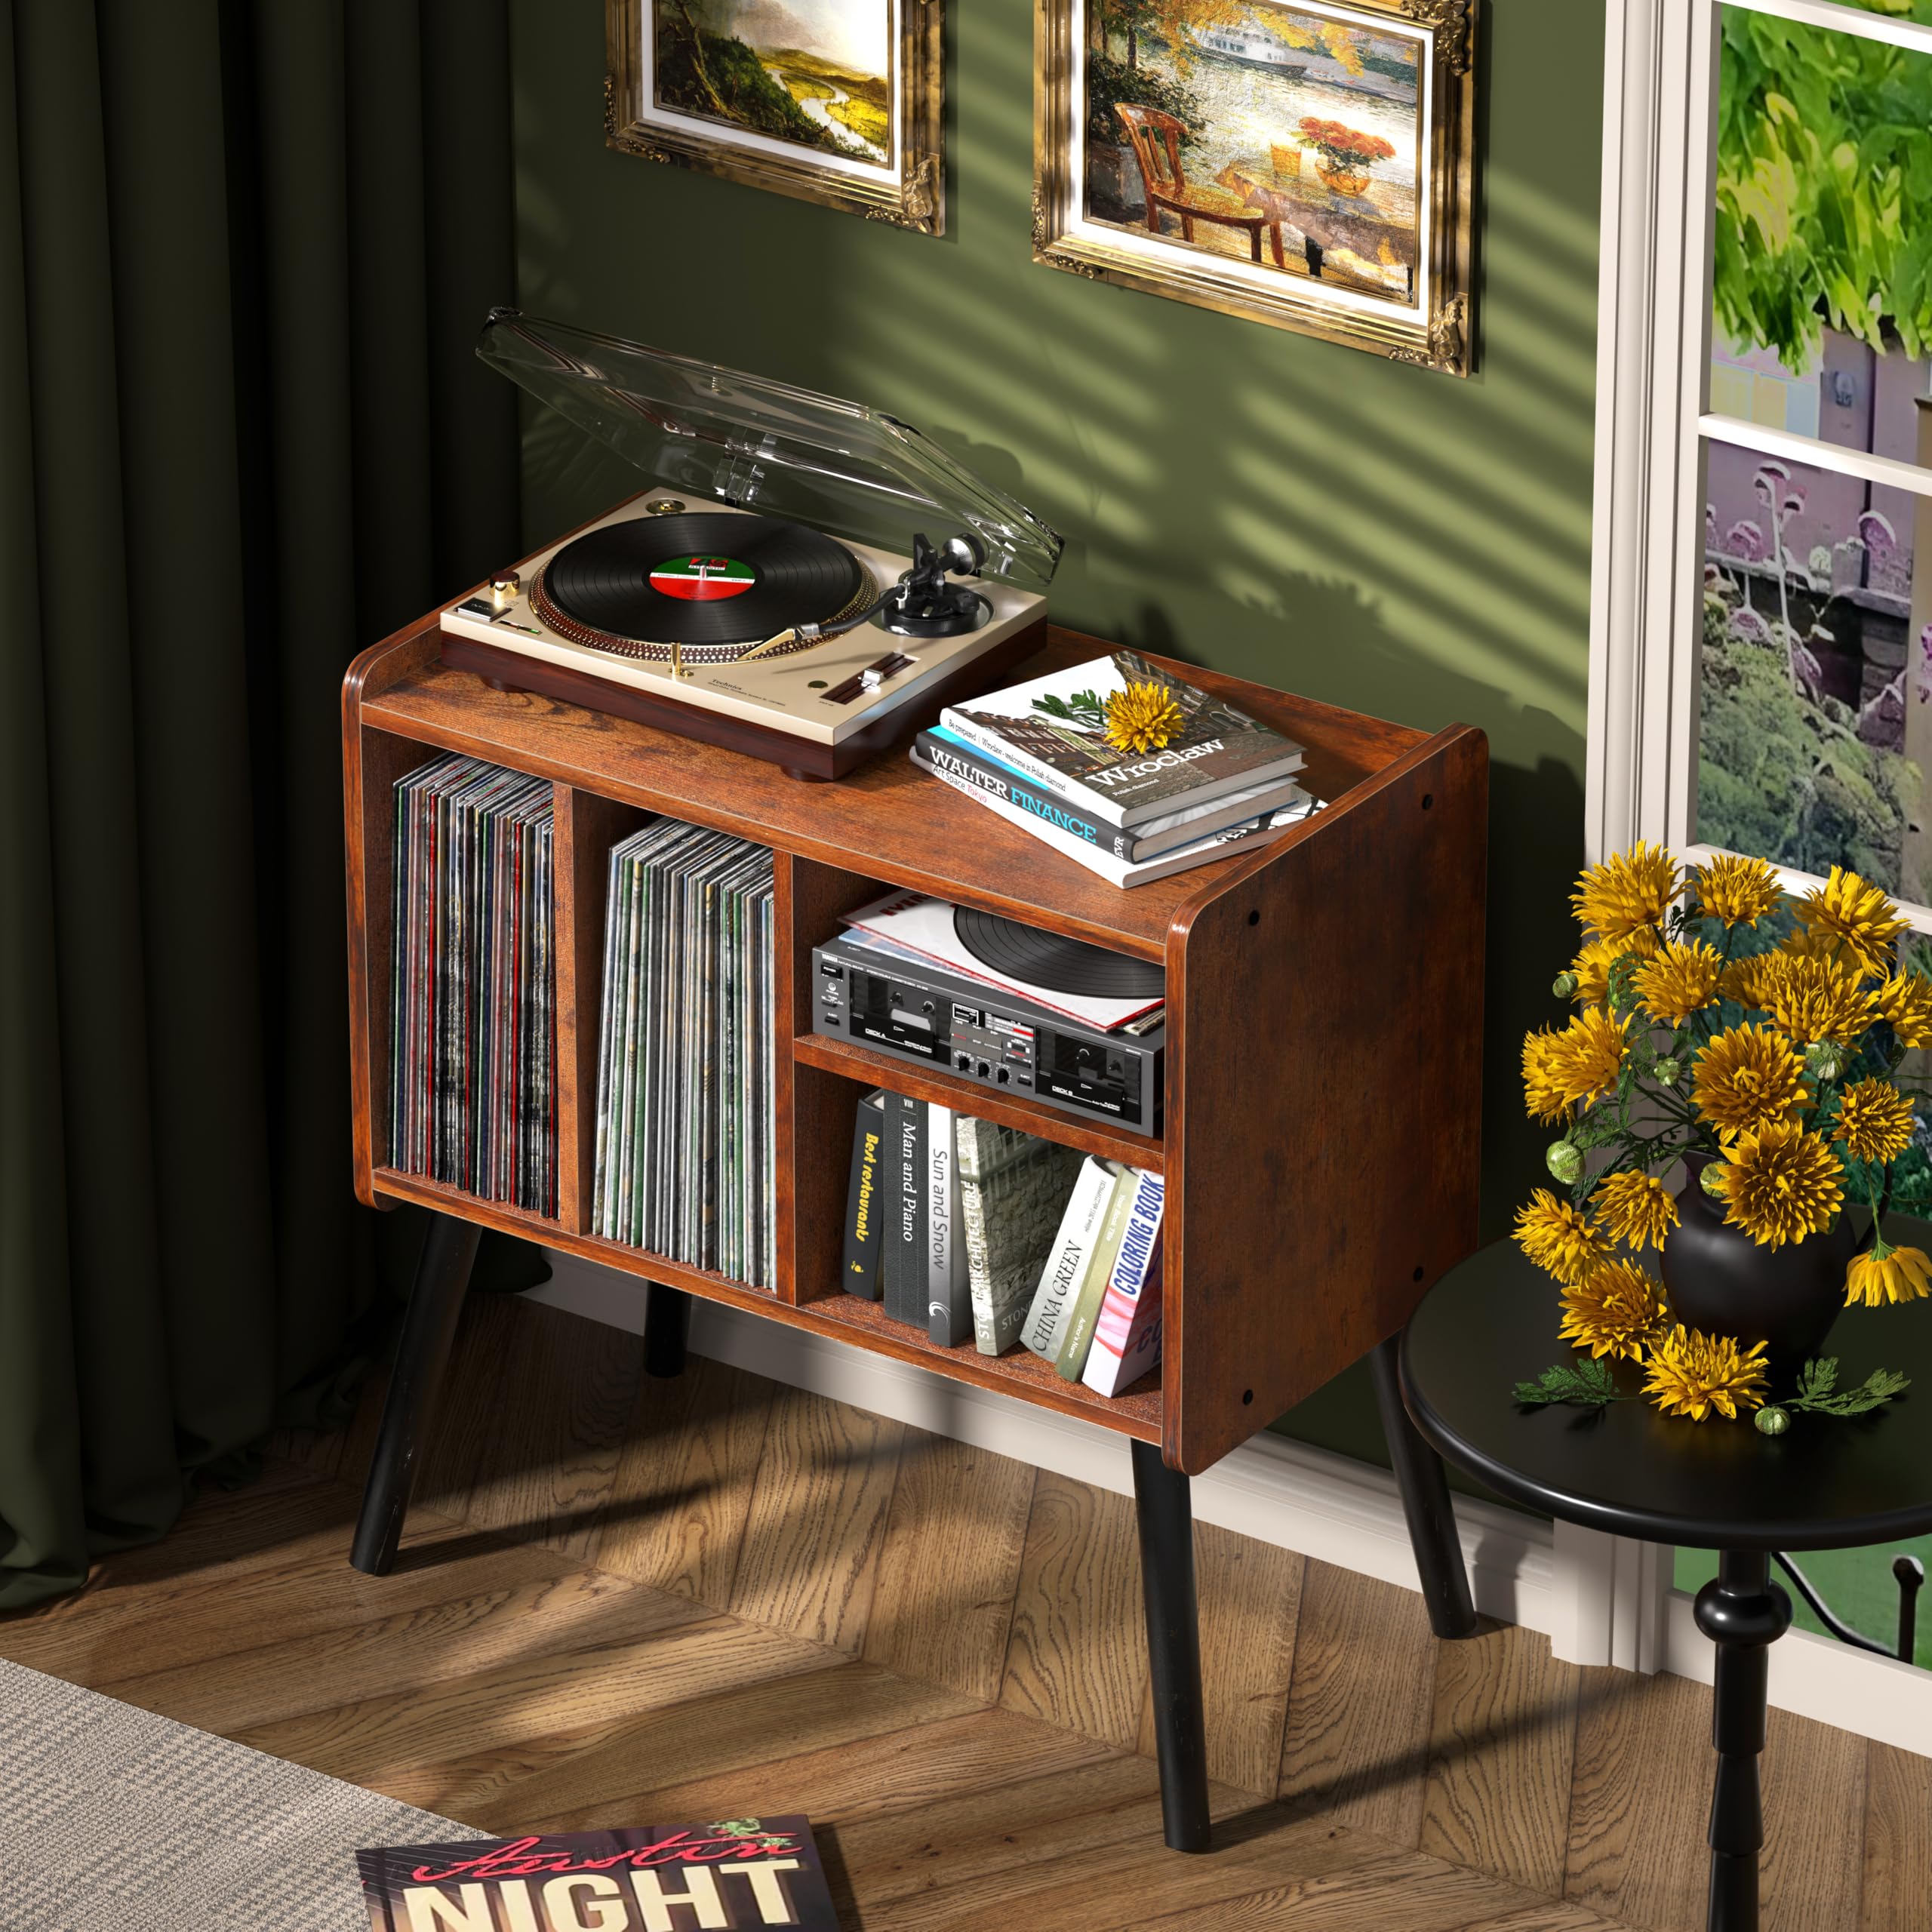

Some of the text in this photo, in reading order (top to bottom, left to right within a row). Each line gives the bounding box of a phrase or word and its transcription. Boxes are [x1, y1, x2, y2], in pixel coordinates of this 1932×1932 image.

[712, 679, 743, 691] Technics
[949, 718, 955, 730] Be
[955, 724, 977, 742] prepared
[1004, 752, 1026, 770] welcome
[1026, 761, 1032, 772] in
[1031, 765, 1045, 780] Polish
[1084, 738, 1226, 786] Wroclaw
[930, 746, 1097, 844] WALTER FINANCE
[934, 764, 987, 803] Art Space Tokyo
[1112, 779, 1160, 797] Polish diamond
[1114, 836, 1124, 859] EVR
[864, 1028, 881, 1038] DECK
[903, 1098, 913, 1109] VIII
[1051, 1085, 1068, 1095] DECK
[855, 1132, 879, 1242] Best restaurants
[903, 1121, 918, 1242] Man and Piano
[933, 1149, 949, 1269] Sun and Snow
[961, 1180, 984, 1287] ARCHITECTURE
[1113, 1174, 1164, 1295] COLORING BOOK
[1032, 1239, 1083, 1352] CHINA GREEN
[1068, 1341, 1078, 1358] Name
[402, 1859, 801, 1932] NIGHT
